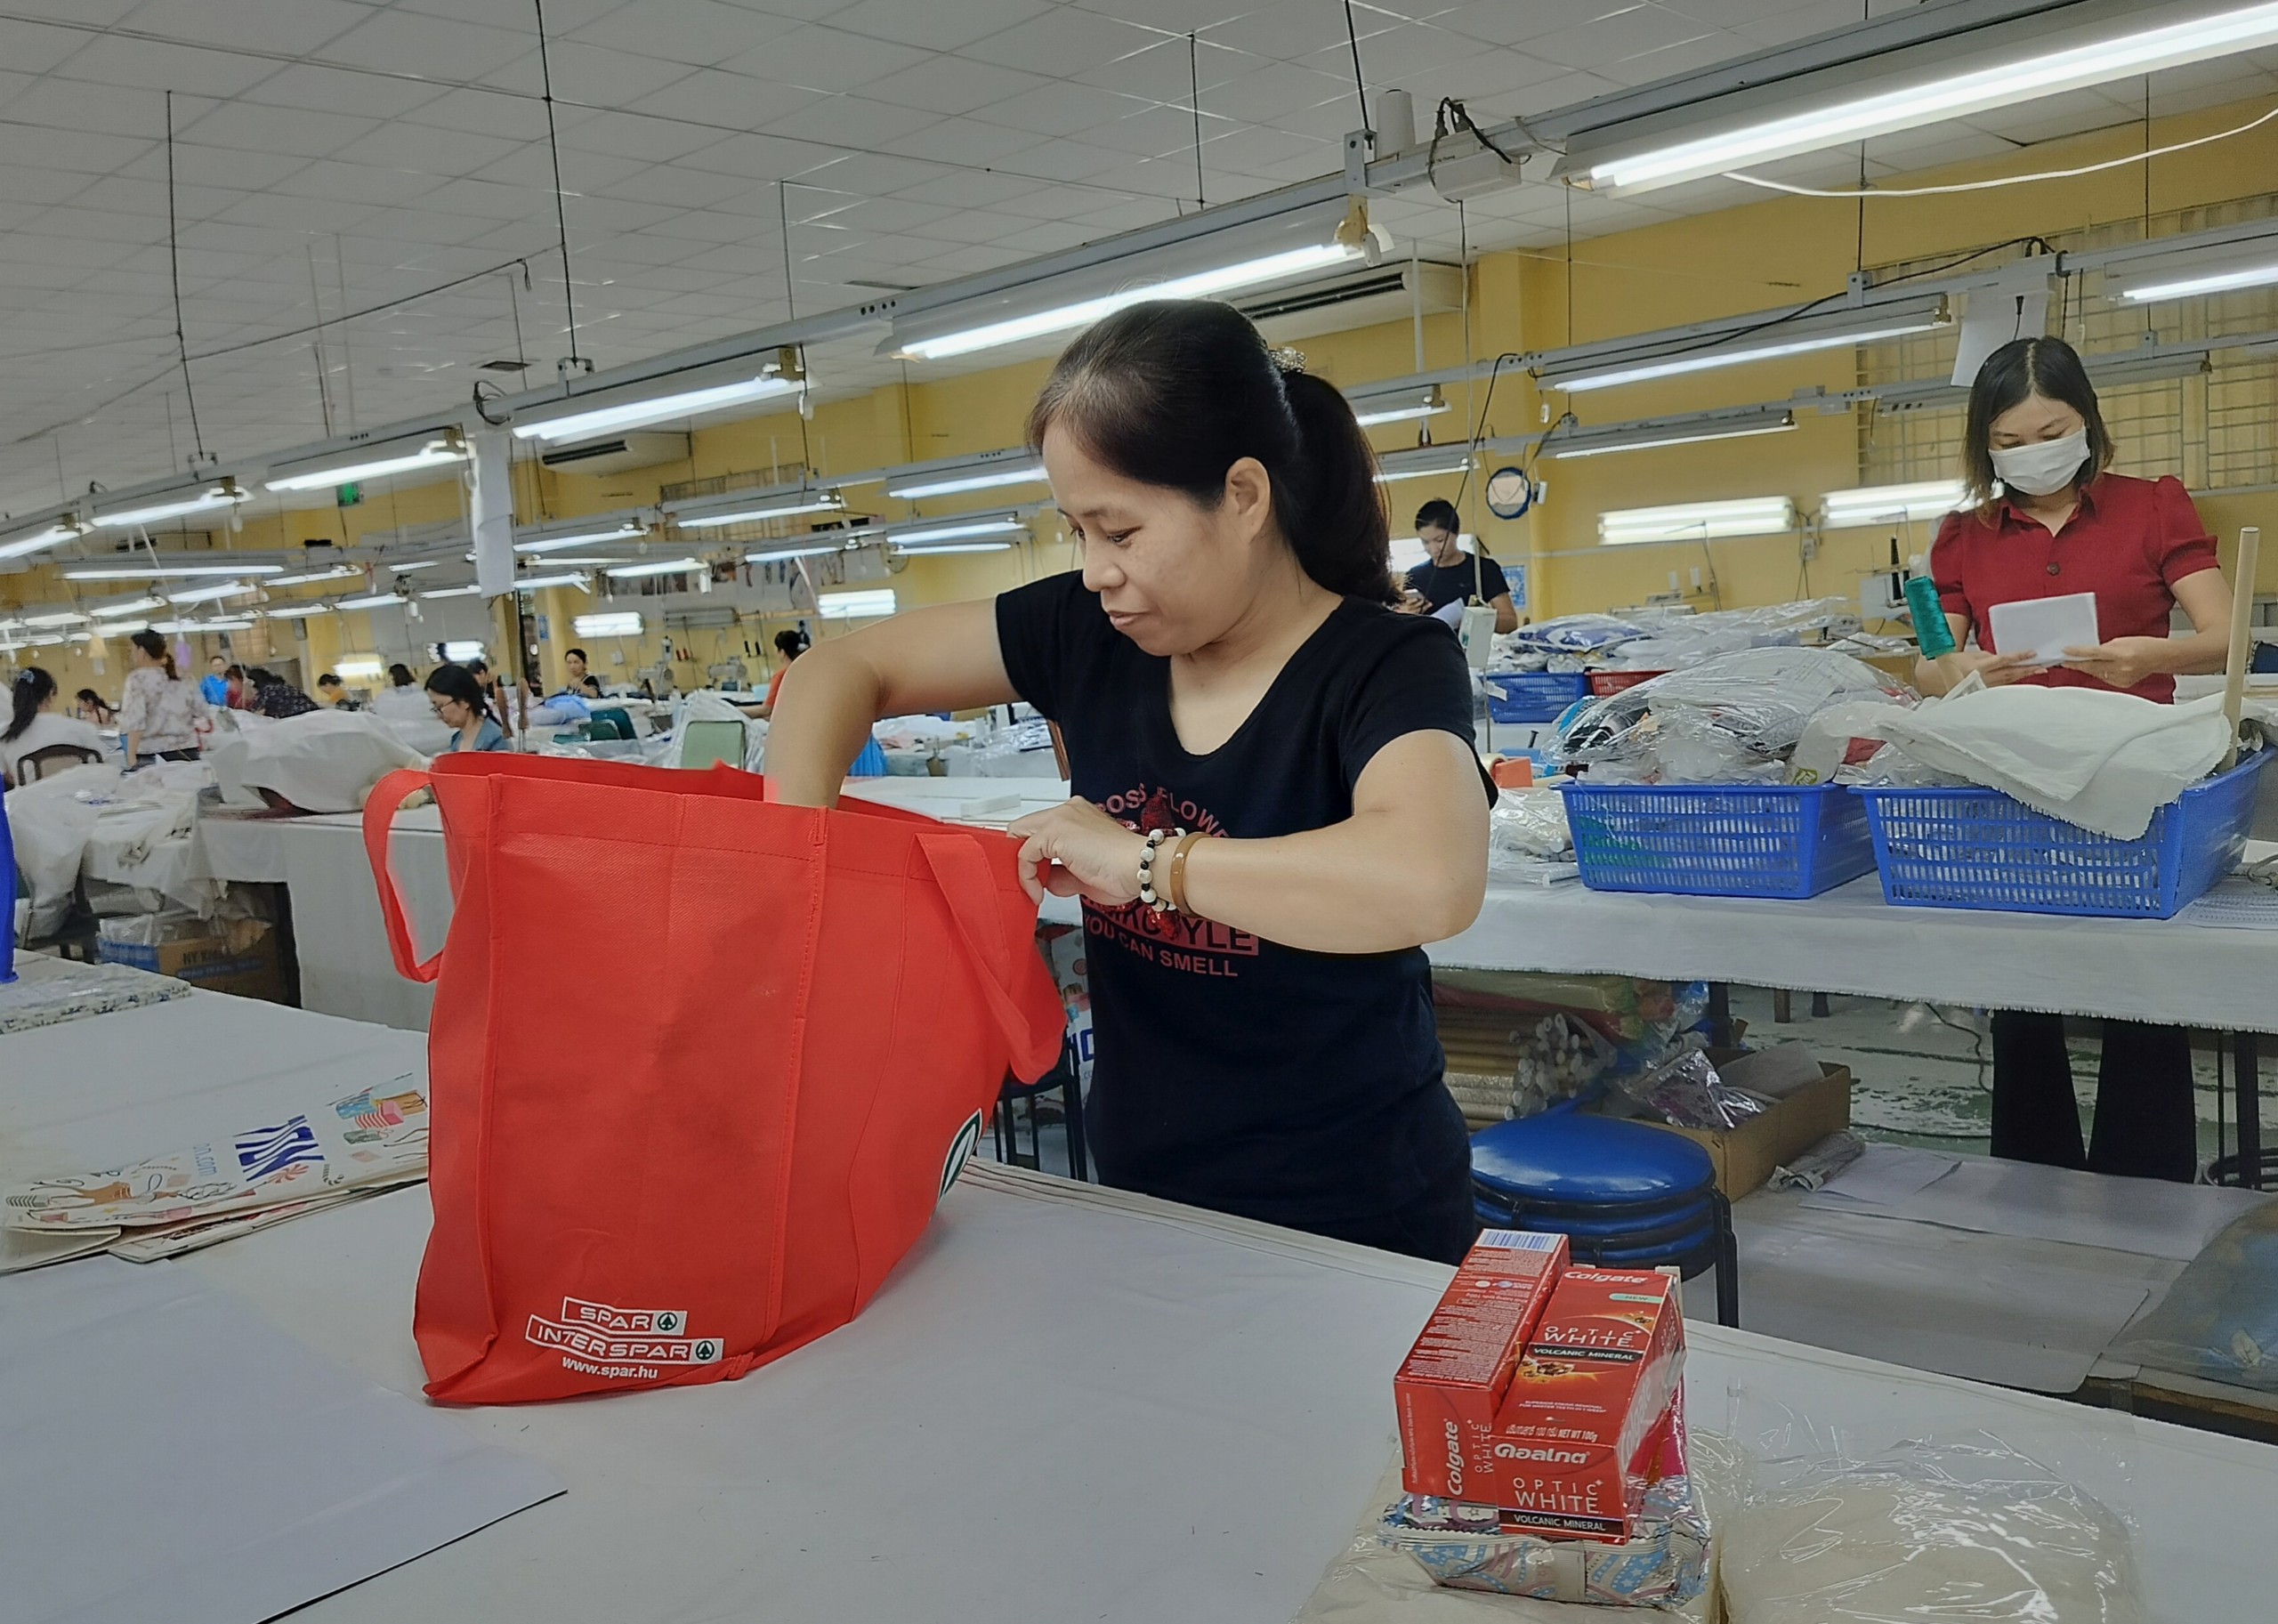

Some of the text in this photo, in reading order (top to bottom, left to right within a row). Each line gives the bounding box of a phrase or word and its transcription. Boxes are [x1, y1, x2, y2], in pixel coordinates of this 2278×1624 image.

[1119, 933, 1154, 962] CAN
[1159, 949, 1239, 978] SMELL
[1563, 1271, 1648, 1284] Colgate
[579, 1307, 650, 1329] SPAR
[537, 1325, 689, 1359] INTERSPAR
[1544, 1332, 1635, 1348] WHITE
[1546, 1326, 1636, 1338] OPTIC
[1534, 1347, 1635, 1361] VOLCANIC MINERAL
[562, 1355, 658, 1380] www.spar.hu
[1558, 1429, 1571, 1439] NET
[1571, 1430, 1581, 1440] WT
[1581, 1431, 1598, 1442] 100g
[1445, 1421, 1465, 1496] Colgate
[1471, 1424, 1483, 1473] OPTIC
[1480, 1423, 1494, 1474] WHITE
[1494, 1443, 1587, 1465] คอลเกต
[1513, 1477, 1598, 1496] OPTIC
[1515, 1490, 1600, 1514] WHITE
[1514, 1514, 1606, 1531] VOLCANIC MINERAL
